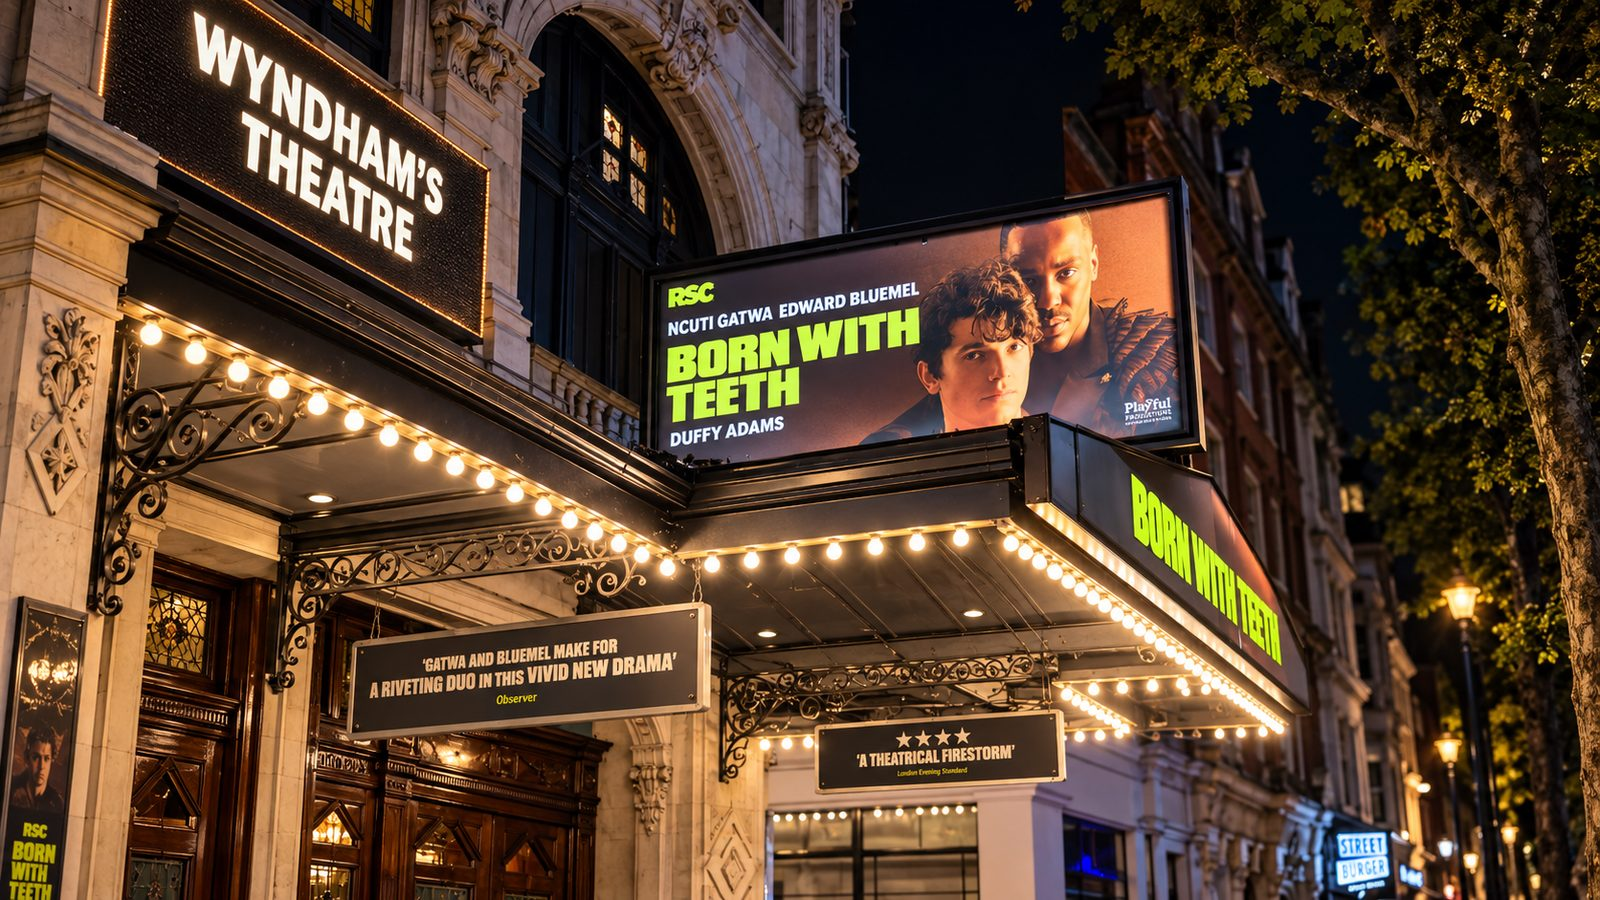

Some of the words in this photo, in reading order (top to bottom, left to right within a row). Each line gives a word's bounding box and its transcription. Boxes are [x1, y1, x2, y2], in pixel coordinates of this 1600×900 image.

[193, 11, 444, 215] WYNDHAM'S
[241, 111, 415, 262] THEATRE
[668, 281, 715, 308] RSC
[668, 316, 714, 337] NCUTI
[717, 306, 773, 329] GATWA
[779, 294, 846, 318] EDWARD
[850, 282, 920, 307] BLUEMEL
[666, 328, 791, 384] BORN
[796, 307, 921, 363] WITH
[666, 366, 800, 423] TEETH
[1124, 397, 1171, 414] Playful
[670, 425, 722, 447] DUFFY
[725, 416, 784, 439] ADAMS
[1131, 473, 1192, 586] BORN
[1191, 530, 1239, 626] WITH
[1236, 575, 1283, 666] TEETH
[469, 652, 494, 668] AND
[497, 646, 551, 665] BLUEMEL
[553, 641, 590, 659] MAKE
[592, 638, 618, 655] FOR
[369, 682, 379, 699] A
[381, 676, 444, 698] RIVETING
[446, 673, 476, 692] DUO
[478, 673, 493, 689] IN
[495, 670, 525, 687] THIS
[527, 663, 569, 684] VIVID
[572, 659, 609, 680] NEW
[496, 693, 537, 705] Observer
[869, 749, 940, 767] THEATRICAL
[23, 822, 48, 839] RSC
[12, 840, 57, 864] BORN
[1341, 837, 1383, 854] STREET
[11, 861, 48, 883] WITH
[1342, 859, 1385, 879] BURGER
[9, 881, 52, 900] TEETH
